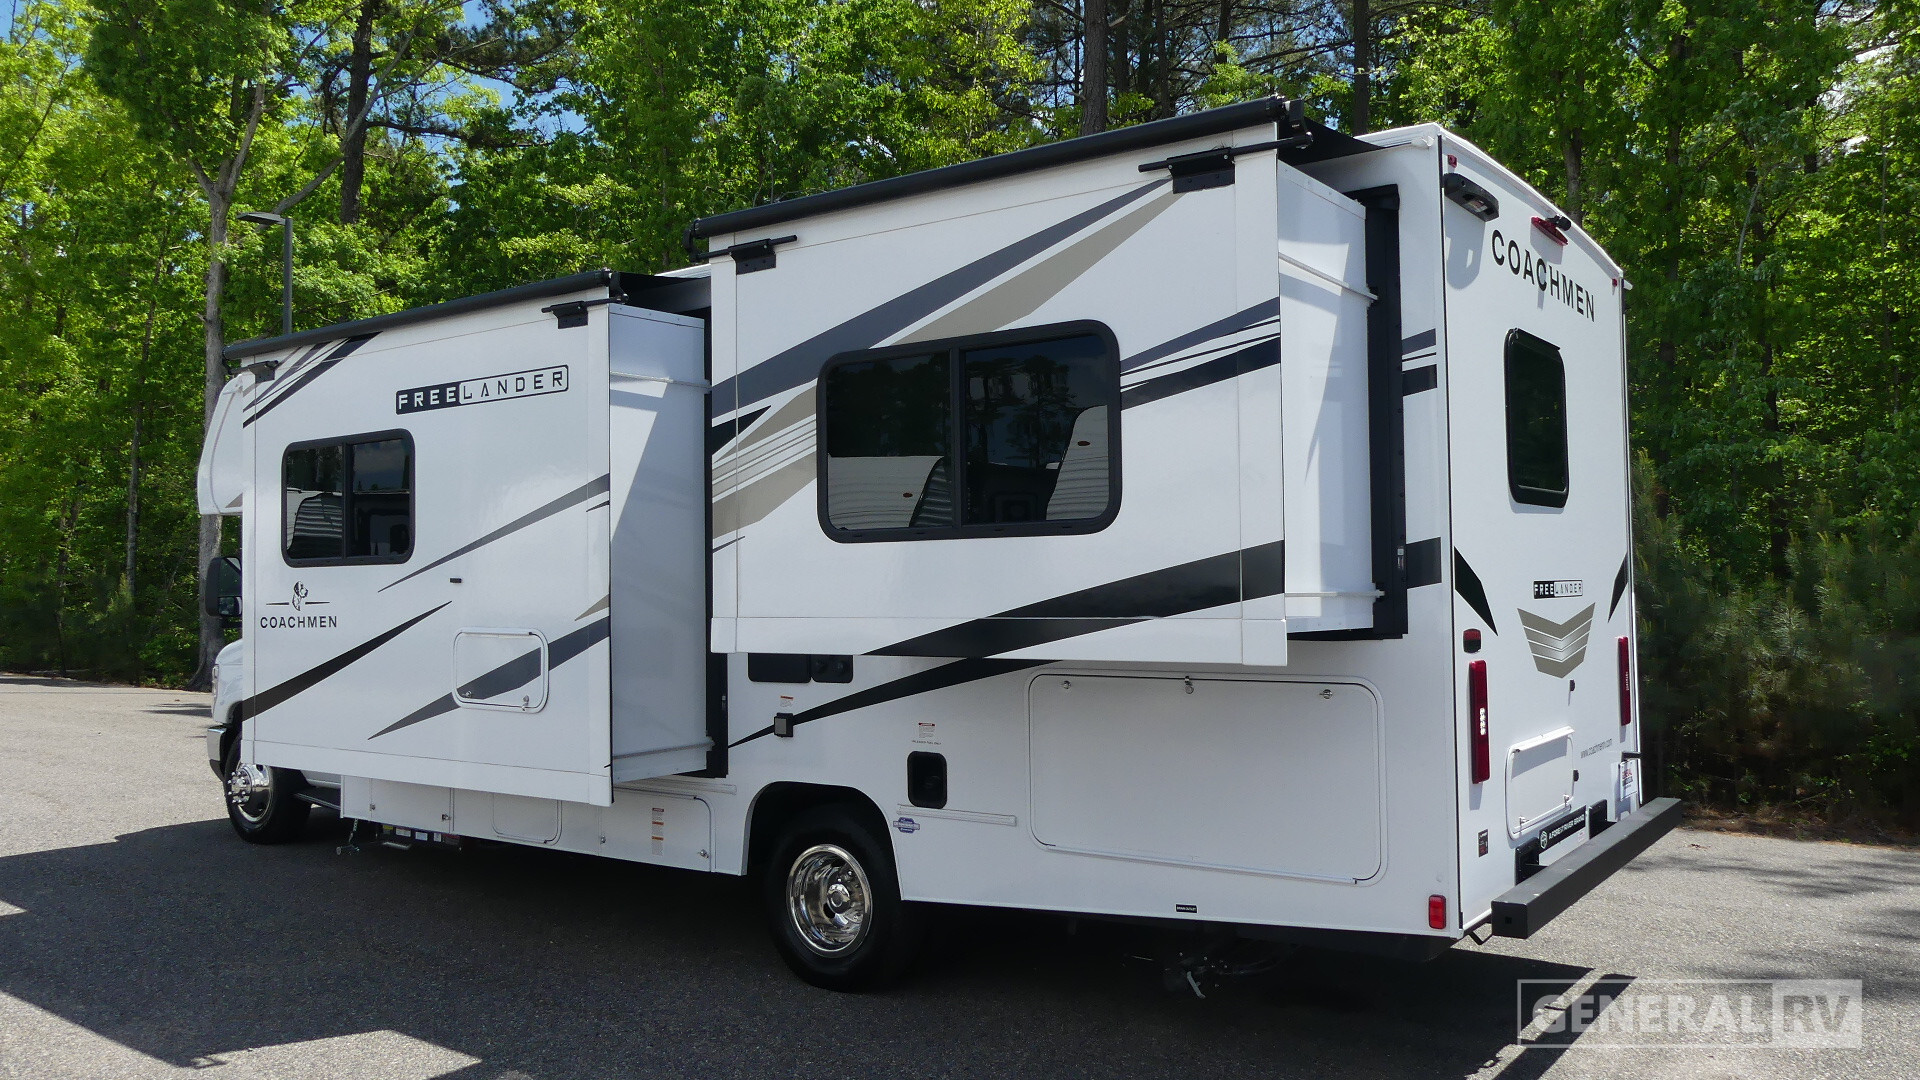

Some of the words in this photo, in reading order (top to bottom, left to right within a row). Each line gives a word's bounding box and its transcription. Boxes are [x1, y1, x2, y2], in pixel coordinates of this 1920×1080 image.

[1491, 229, 1595, 323] COACHMEN
[398, 370, 563, 410] FREELANDER
[1534, 583, 1582, 596] FREELANDER
[260, 616, 337, 629] COACHMEN
